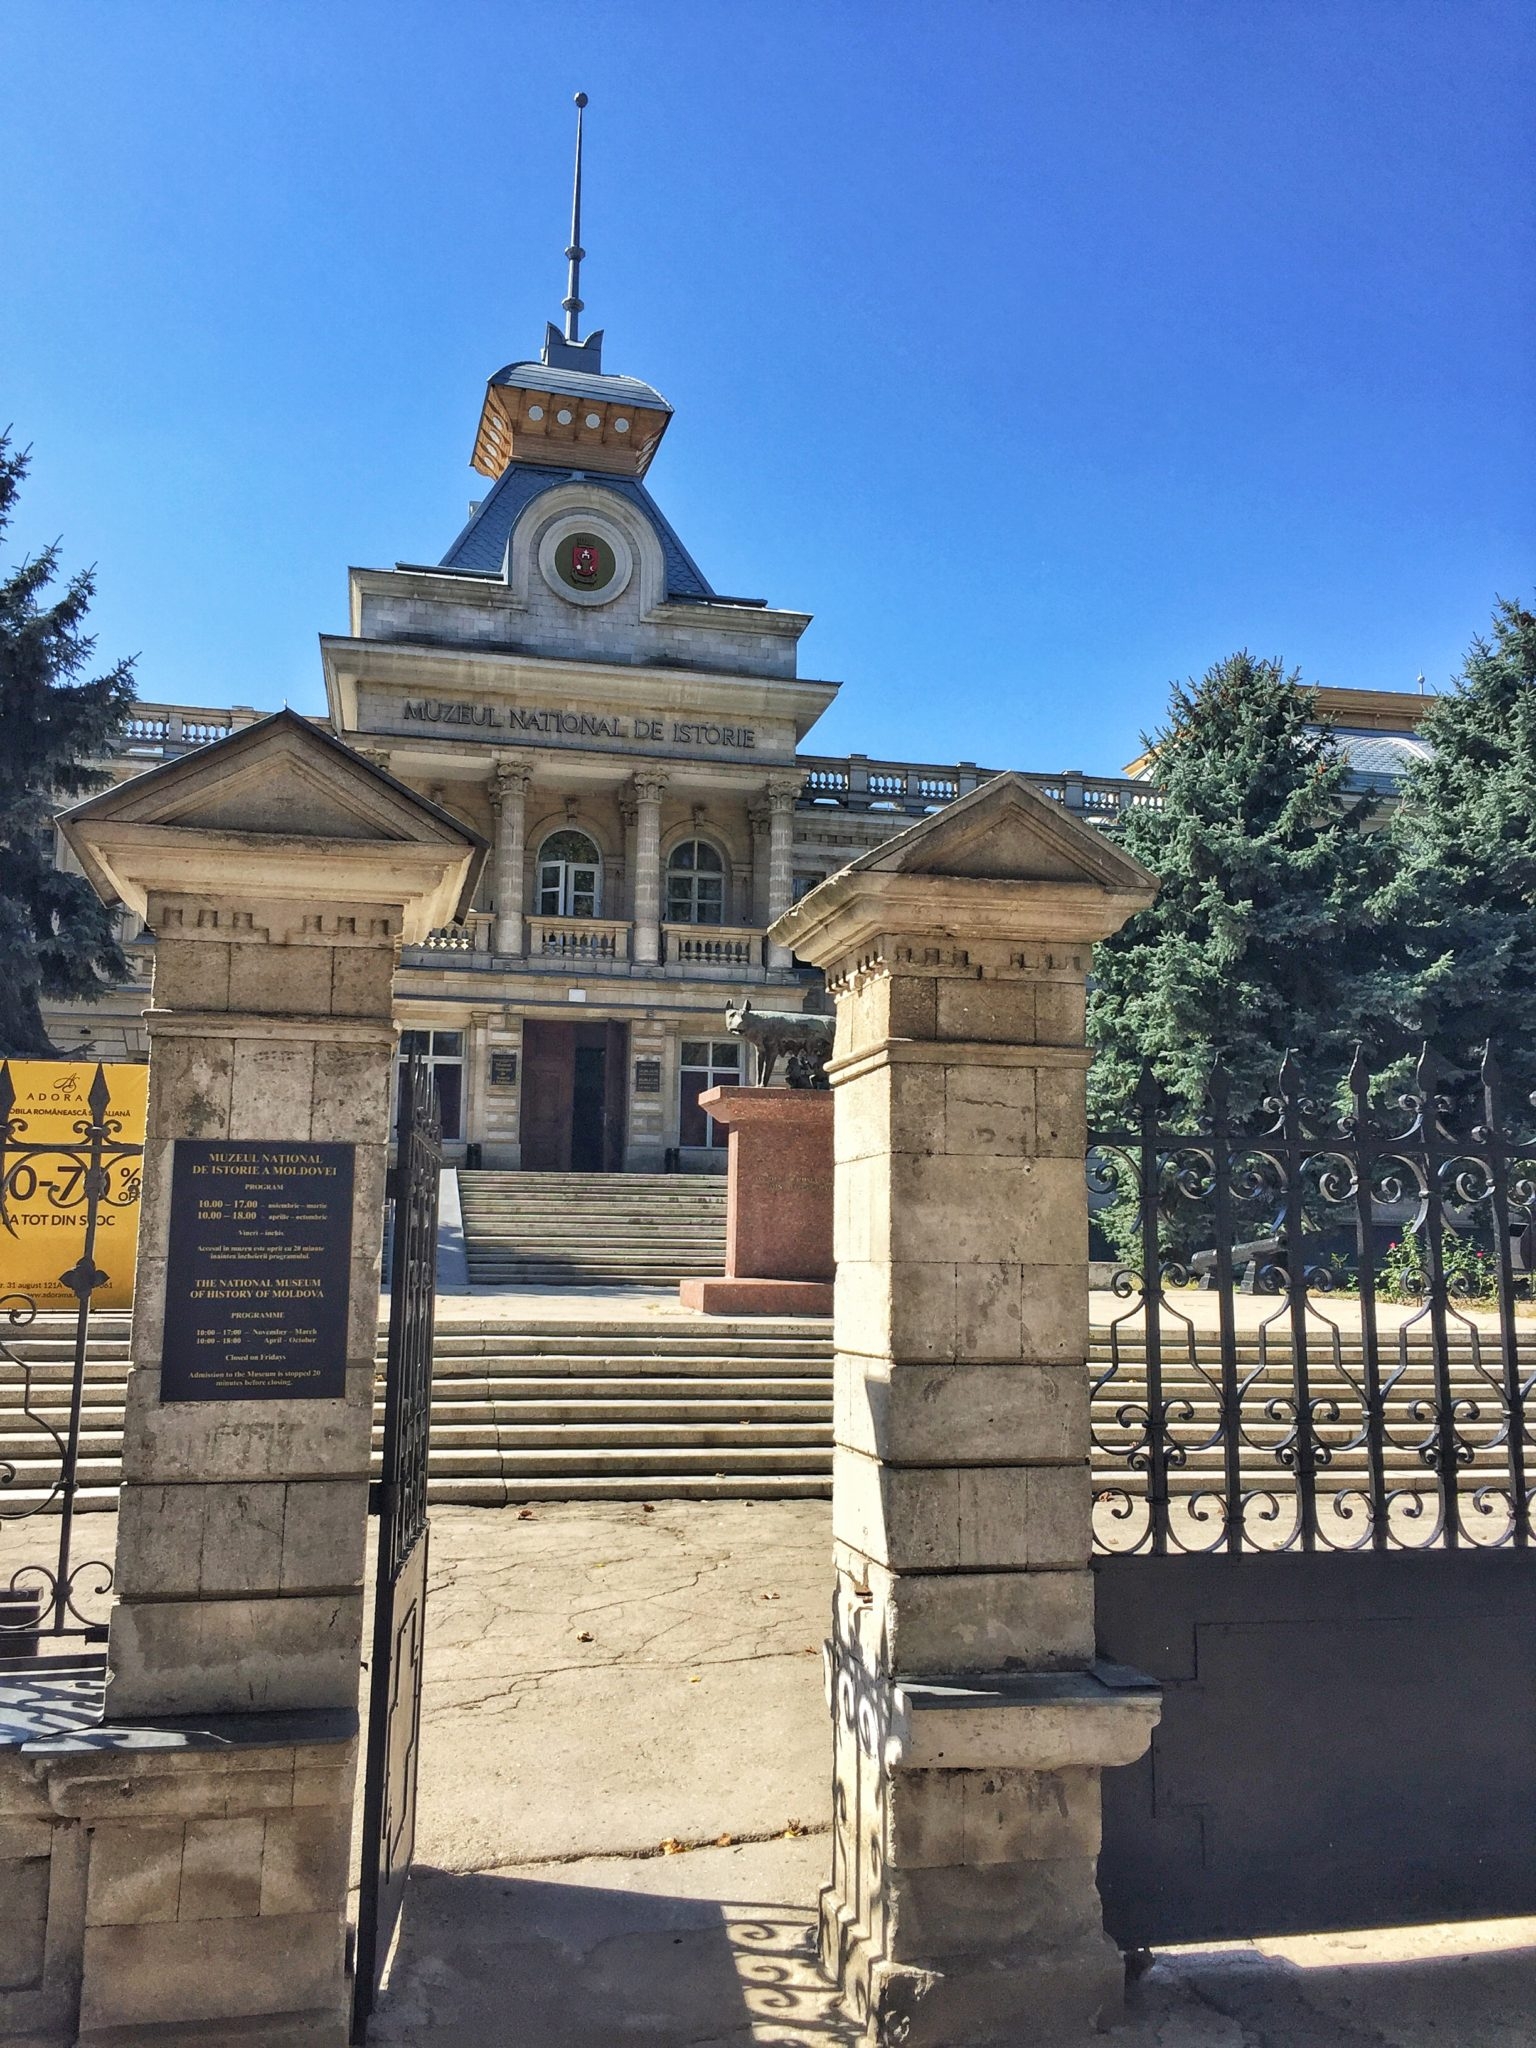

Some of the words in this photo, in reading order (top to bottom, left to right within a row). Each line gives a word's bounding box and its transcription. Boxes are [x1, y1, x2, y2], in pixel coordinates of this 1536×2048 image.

[404, 699, 502, 728] MUZEUL
[509, 709, 622, 738] NATIONAL
[634, 720, 664, 741] DE
[673, 722, 756, 749] ISTORIE
[26, 1093, 83, 1102] ADORA
[209, 1153, 260, 1163] MUZEUL
[192, 1165, 209, 1174] DE
[211, 1165, 260, 1175] ISTORIE
[263, 1166, 270, 1175] A
[273, 1166, 337, 1176] MOLDOVEI
[199, 1200, 223, 1208] 10.00
[234, 1200, 258, 1208] 17.00
[21, 1214, 49, 1225] TOT
[51, 1215, 76, 1226] DIN
[79, 1215, 116, 1226] SOC
[197, 1211, 222, 1220] 10.00
[233, 1211, 257, 1220] 18.00
[18, 1282, 42, 1292] august
[194, 1279, 217, 1287] THE
[219, 1279, 273, 1287] NATIONAL
[275, 1278, 321, 1287] MUSEUM
[190, 1290, 205, 1298] OF
[207, 1290, 252, 1298] HISTORY
[255, 1290, 270, 1298] OF
[272, 1290, 324, 1298] MOLDOVA
[260, 1354, 286, 1362] Fridays
